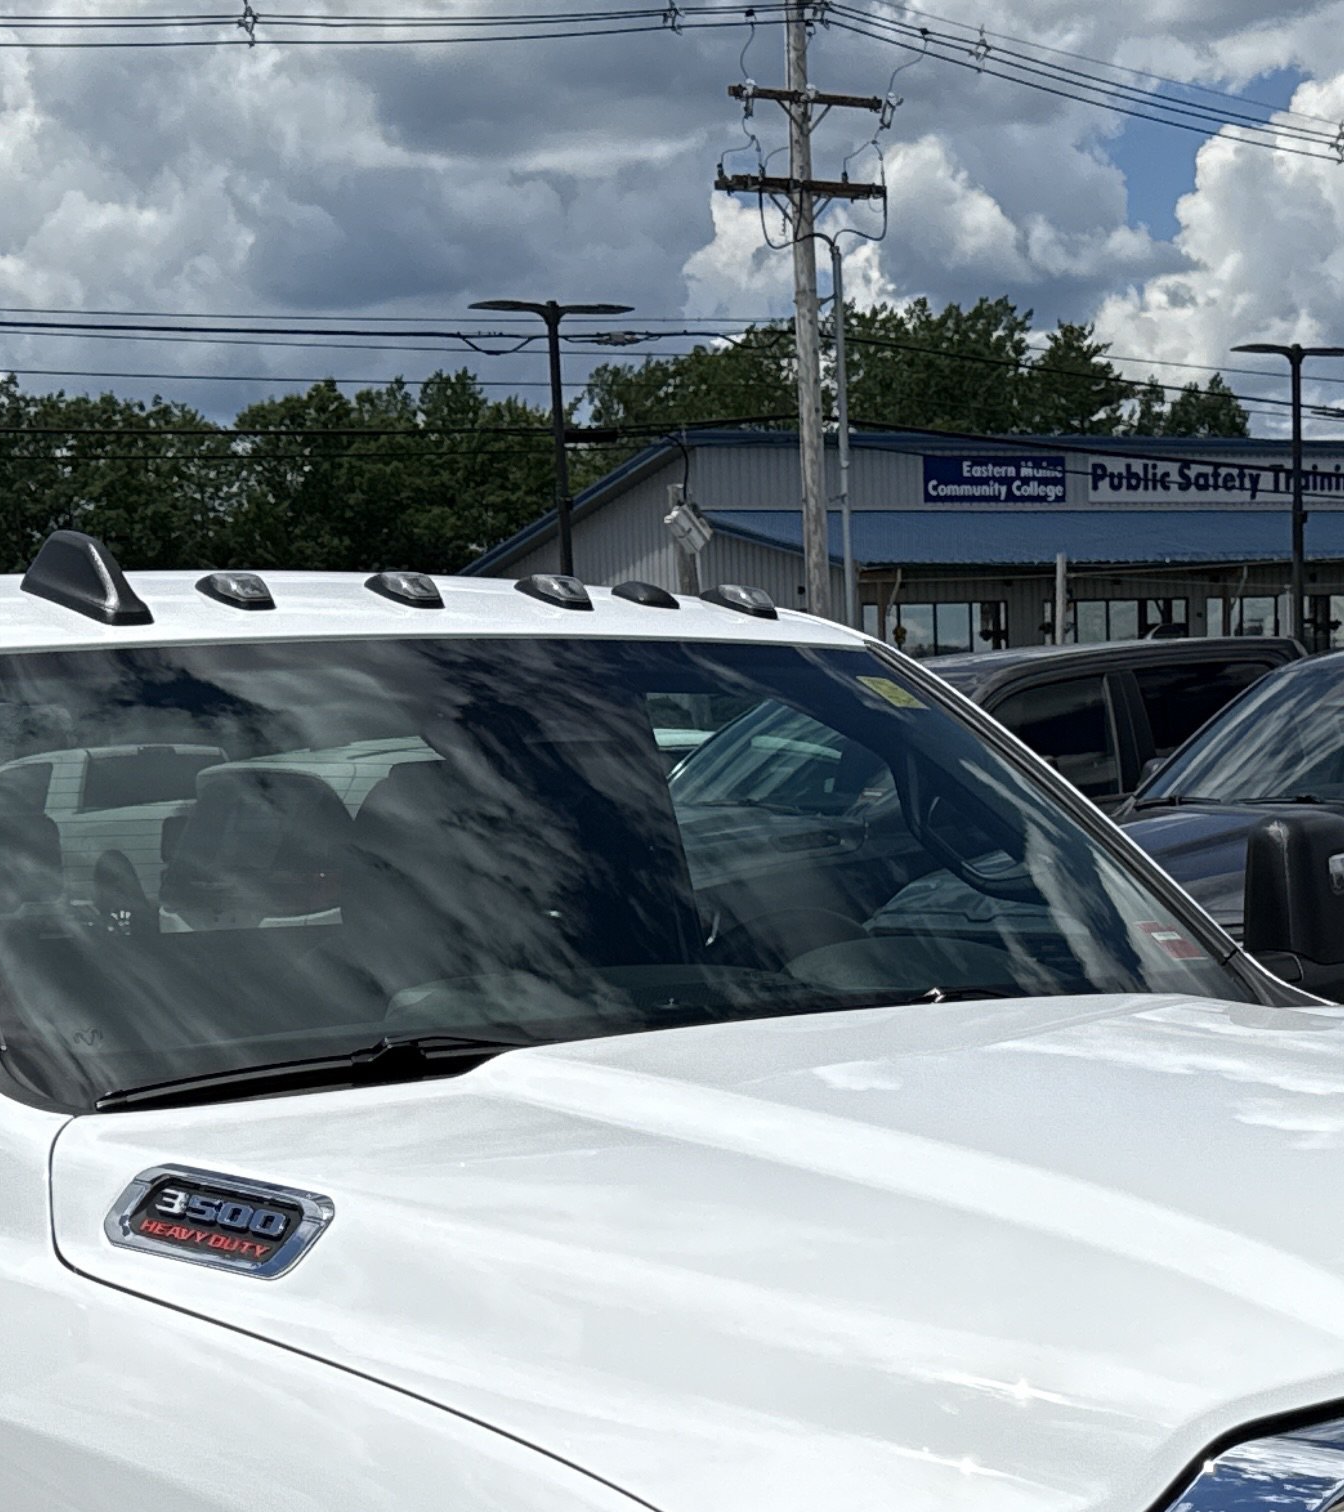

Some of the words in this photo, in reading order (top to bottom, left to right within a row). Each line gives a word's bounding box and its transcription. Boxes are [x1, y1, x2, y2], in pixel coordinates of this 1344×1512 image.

[962, 460, 1016, 478] Eastern
[1091, 462, 1171, 491] Public
[1178, 462, 1261, 500] Safety
[928, 480, 1007, 501] Community
[1012, 480, 1064, 501] College
[155, 1188, 288, 1237] 3500
[140, 1219, 206, 1244] HEAVY
[208, 1233, 271, 1258] DUTY
